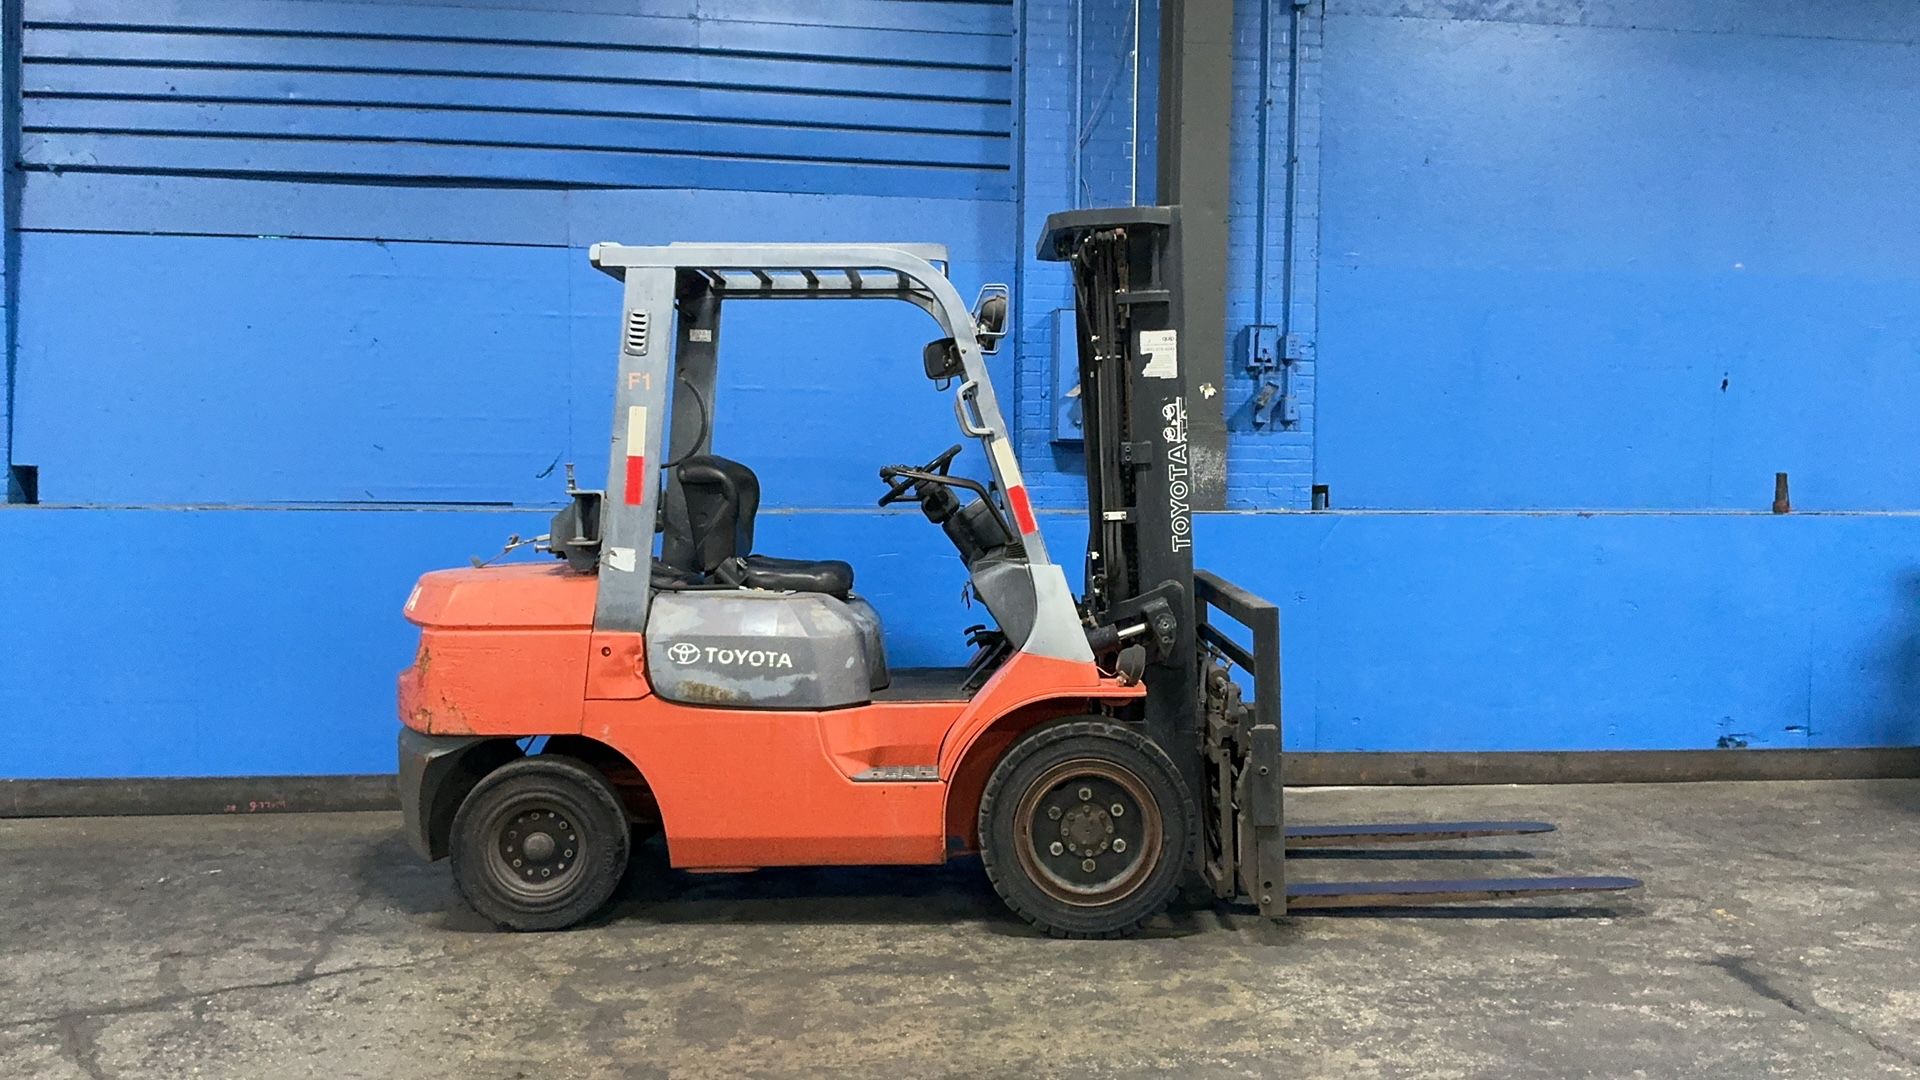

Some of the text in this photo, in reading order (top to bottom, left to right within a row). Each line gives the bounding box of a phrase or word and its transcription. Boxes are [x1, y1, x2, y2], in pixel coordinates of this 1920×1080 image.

[628, 372, 651, 390] F1
[1167, 443, 1191, 553] TOYOTA
[705, 647, 793, 668] TOYOTA
